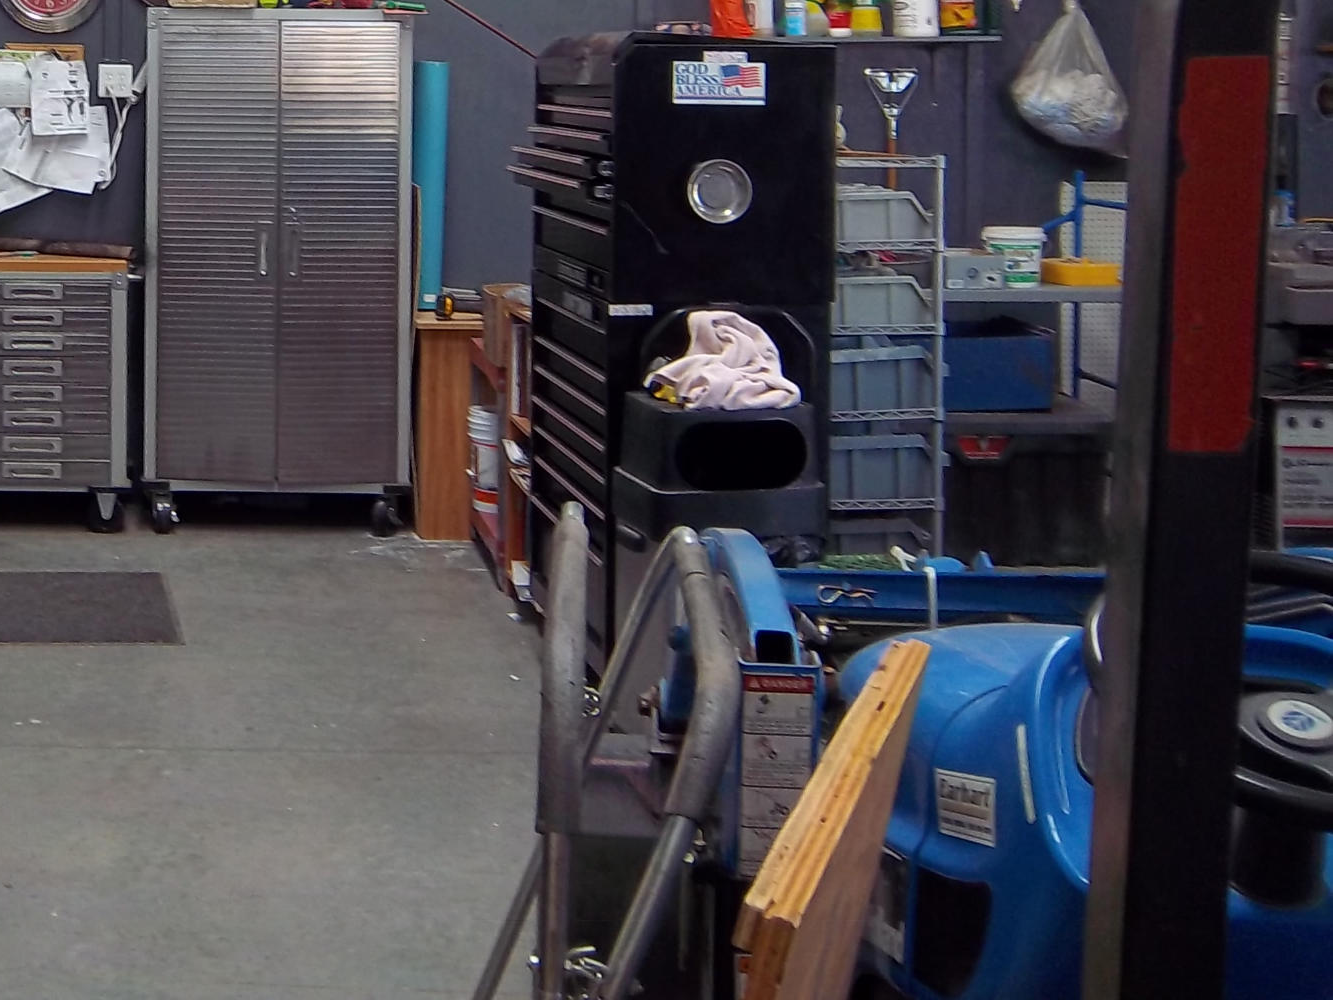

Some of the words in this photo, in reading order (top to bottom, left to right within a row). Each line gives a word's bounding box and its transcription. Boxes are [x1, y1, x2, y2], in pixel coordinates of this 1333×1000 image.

[675, 63, 708, 75] GOD
[676, 74, 719, 85] BLESS
[676, 85, 743, 97] AMERICA
